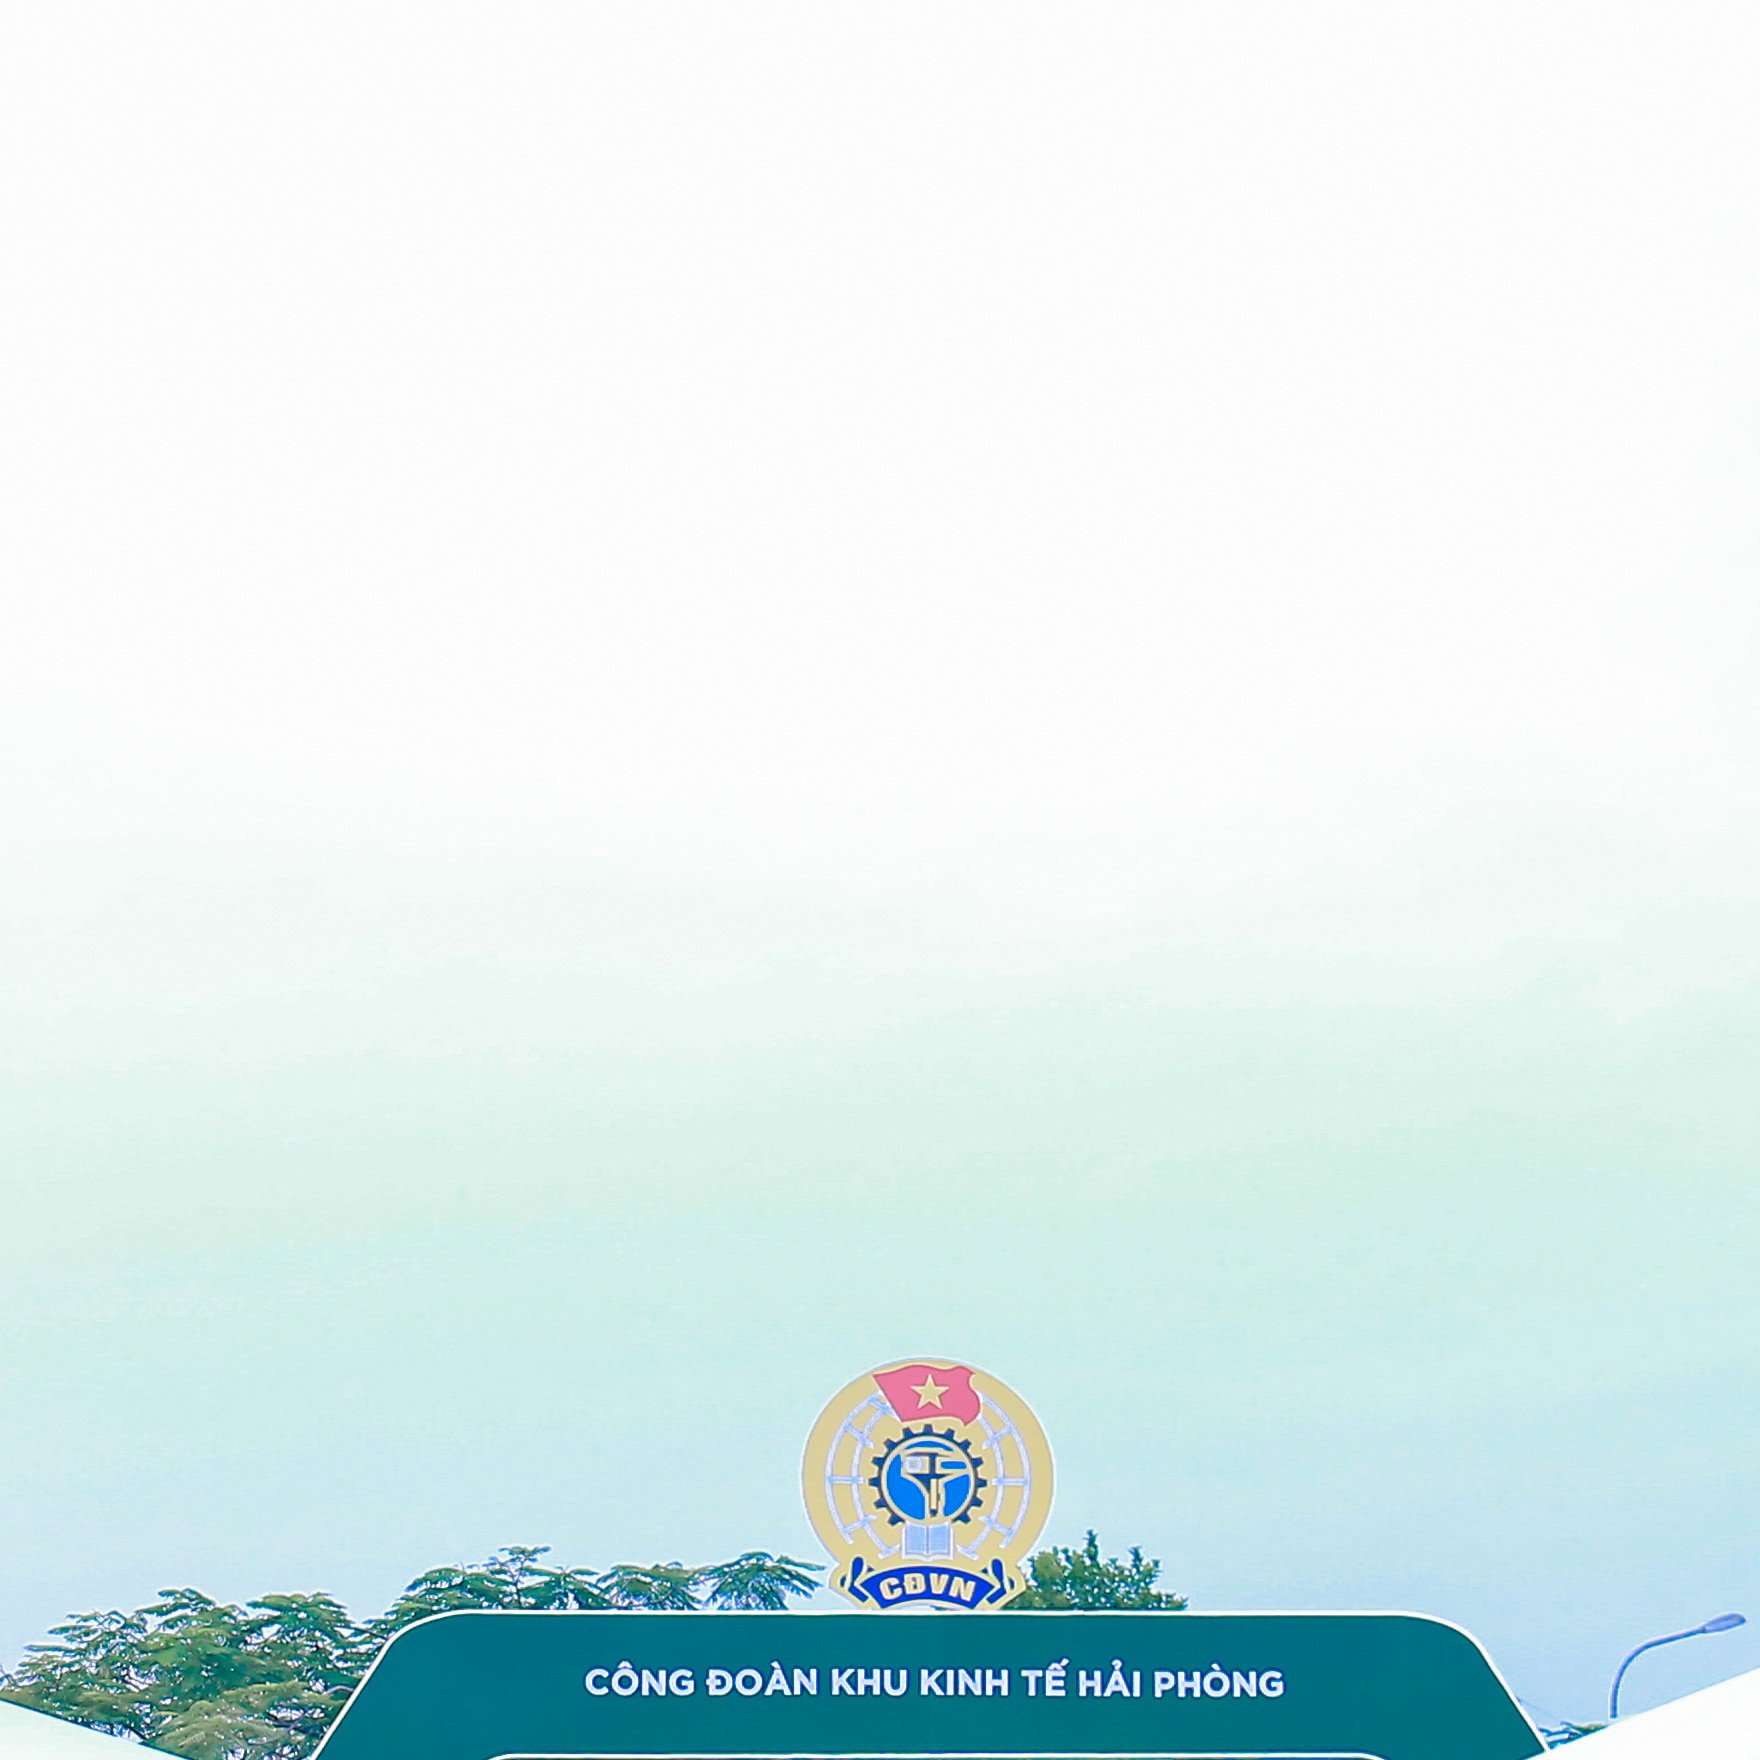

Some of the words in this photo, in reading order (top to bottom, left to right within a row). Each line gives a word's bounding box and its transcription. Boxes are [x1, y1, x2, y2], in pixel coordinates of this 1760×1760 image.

[879, 1573, 976, 1602] CĐVN
[585, 1661, 695, 1696] CÔNG
[706, 1661, 817, 1696] ĐOÀN
[831, 1668, 907, 1696] KHU
[920, 1669, 1009, 1696] KINH
[1021, 1658, 1069, 1697] TẾ
[1079, 1659, 1141, 1697] HẢI
[1154, 1663, 1284, 1698] PHÒNG
